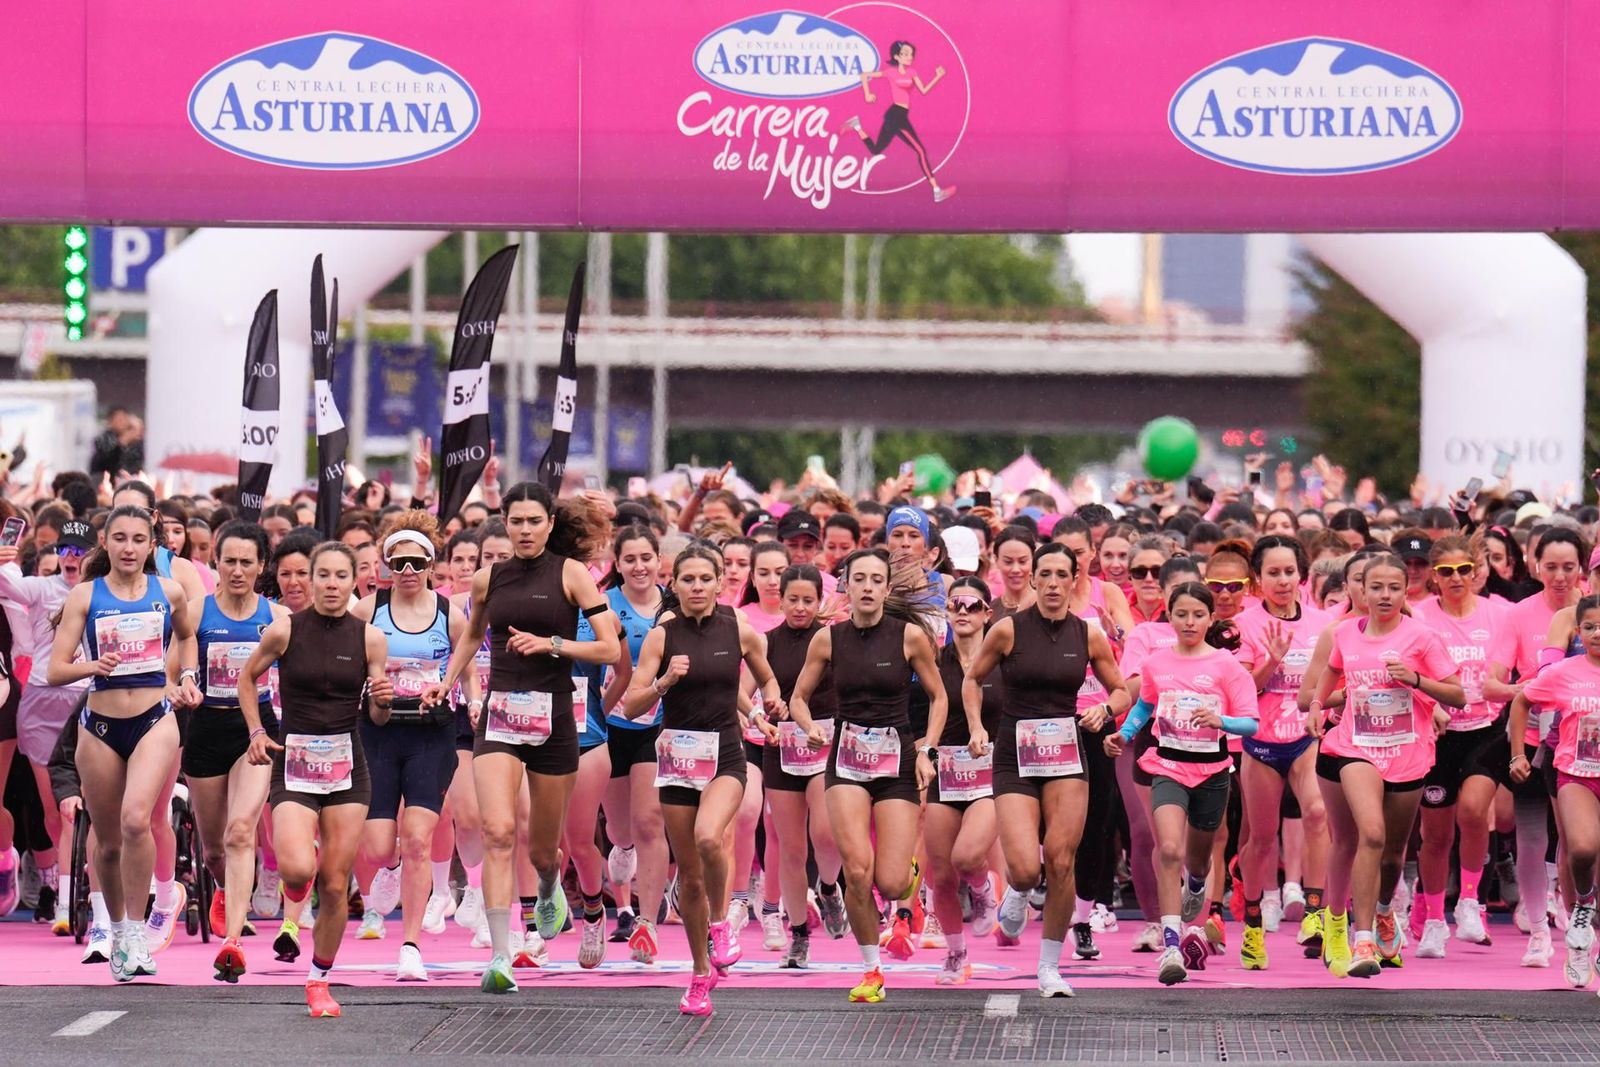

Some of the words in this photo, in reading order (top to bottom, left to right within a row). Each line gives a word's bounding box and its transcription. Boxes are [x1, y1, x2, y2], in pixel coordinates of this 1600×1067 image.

[737, 41, 794, 50] CENTRAL
[801, 41, 859, 50] LECHERA
[709, 43, 863, 75] ASTURIANA
[256, 80, 347, 93] CENTRAL
[356, 82, 447, 94] LECHERA
[1237, 86, 1327, 98] CENTRAL
[1337, 86, 1429, 98] LECHERA
[211, 82, 457, 133] ASTURIANA
[1191, 89, 1439, 138] ASTURIANA
[676, 91, 830, 138] Carrera
[713, 140, 742, 171] de
[748, 140, 768, 171] la
[763, 133, 886, 209] Mujer
[111, 227, 150, 287] P
[462, 321, 495, 338] OYSH
[446, 446, 485, 467] OYSHO
[242, 492, 265, 509] OYSH
[120, 640, 146, 652] 016
[399, 679, 421, 691] 016
[1448, 703, 1472, 714] 06
[507, 714, 530, 725] 016
[1371, 716, 1394, 726] 016
[1037, 746, 1061, 756] 016
[673, 757, 696, 769] 016
[856, 752, 879, 764] 016
[307, 762, 332, 773] 016
[955, 770, 977, 781] 016
